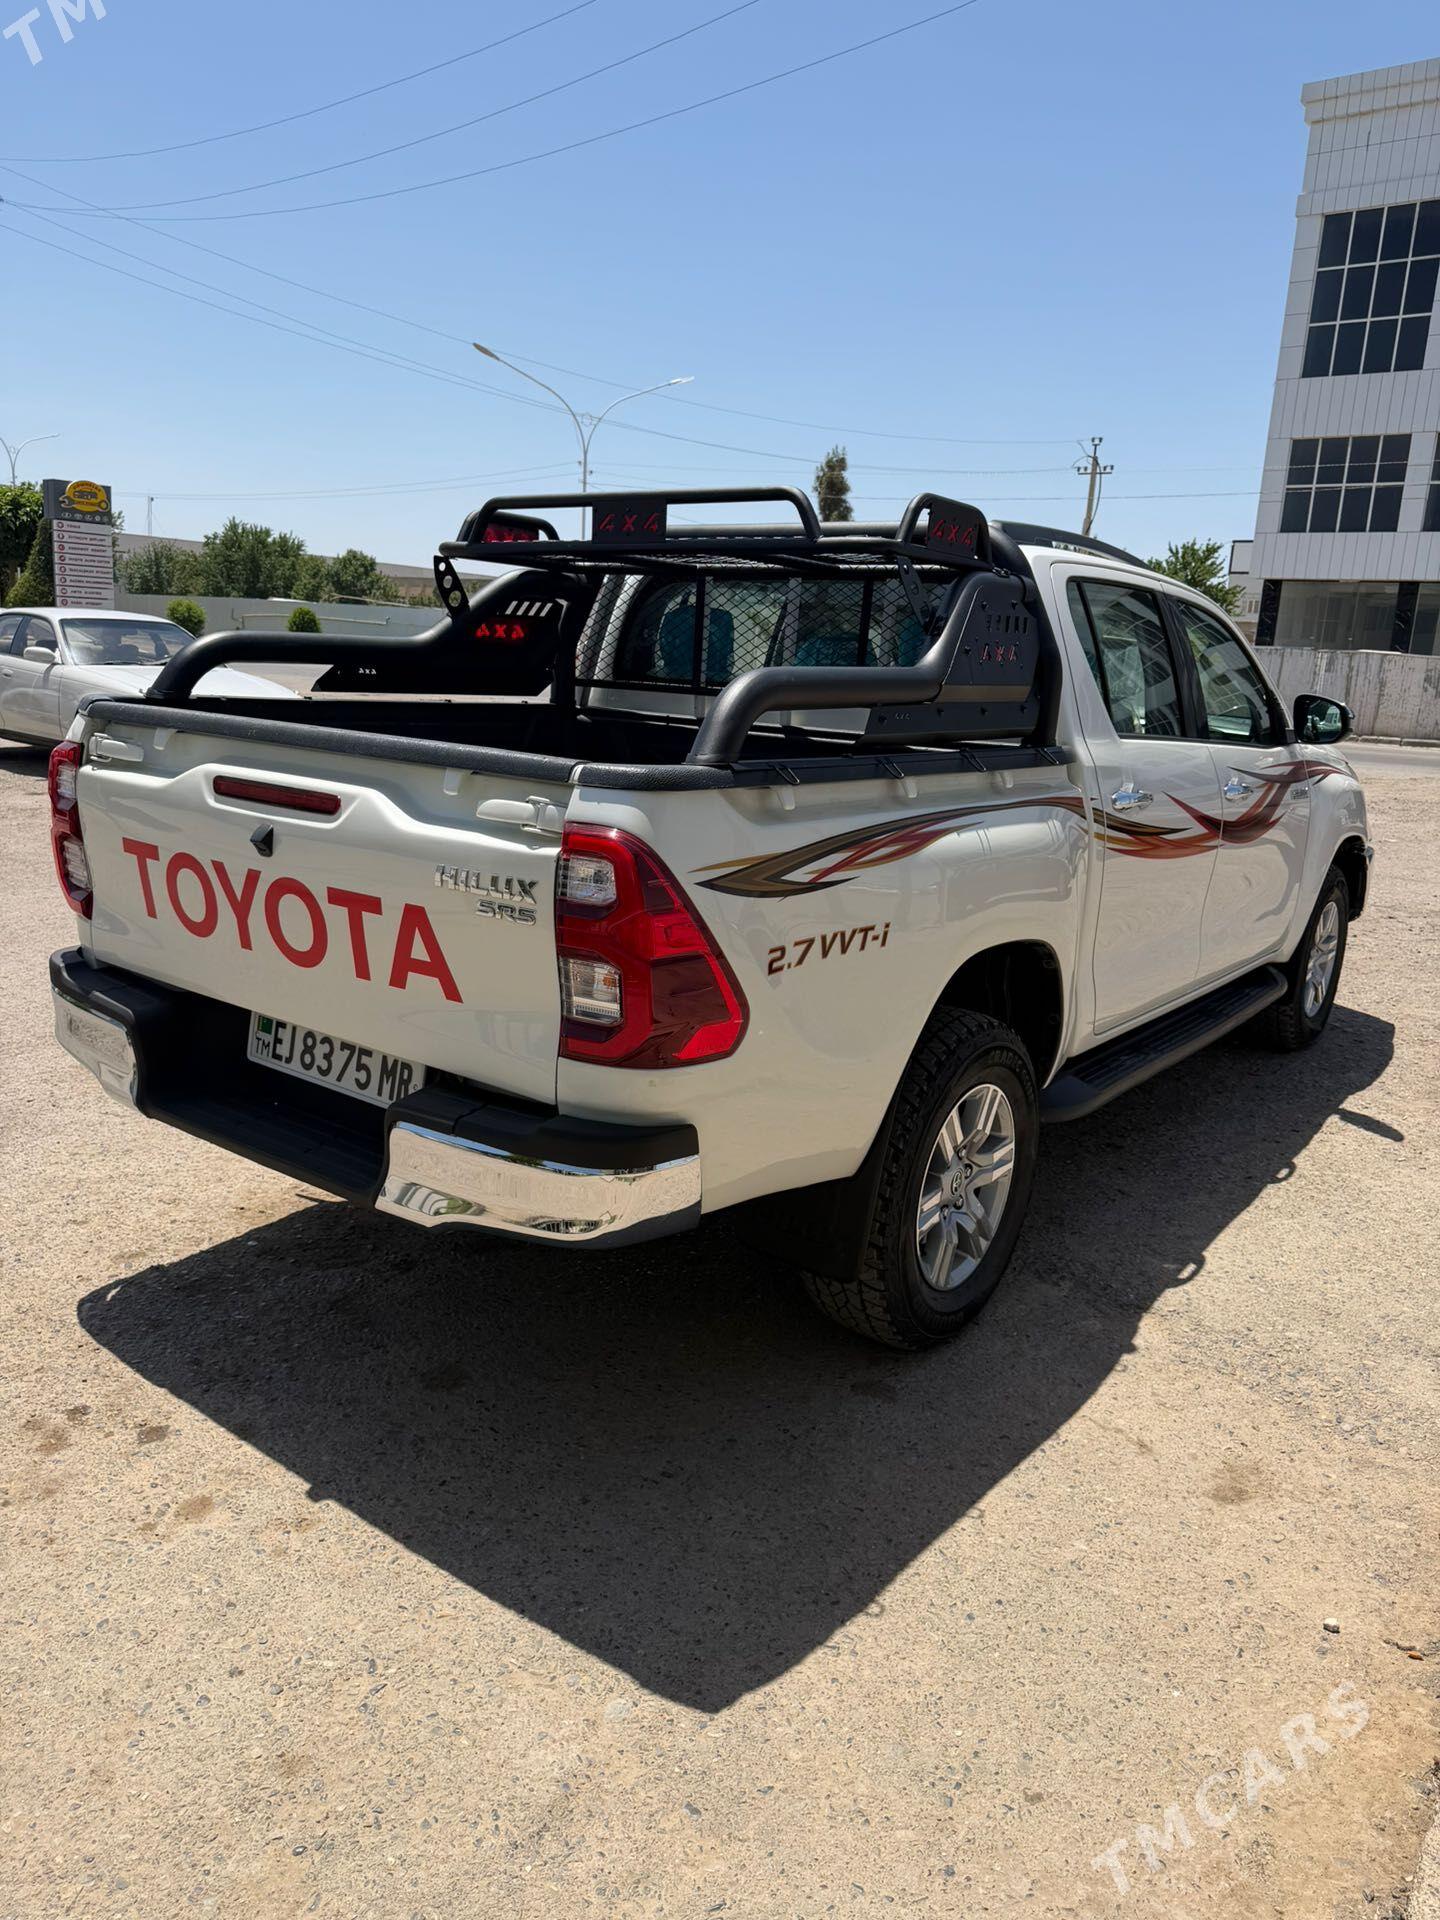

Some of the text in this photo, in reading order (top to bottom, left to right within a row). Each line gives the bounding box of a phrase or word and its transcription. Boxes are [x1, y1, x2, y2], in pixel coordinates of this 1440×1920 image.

[434, 863, 539, 905] HILUX
[122, 837, 464, 1004] TOYOTA
[475, 899, 537, 926] SRS
[767, 921, 891, 976] 2.7 VVT-i
[255, 1037, 271, 1058] TM
